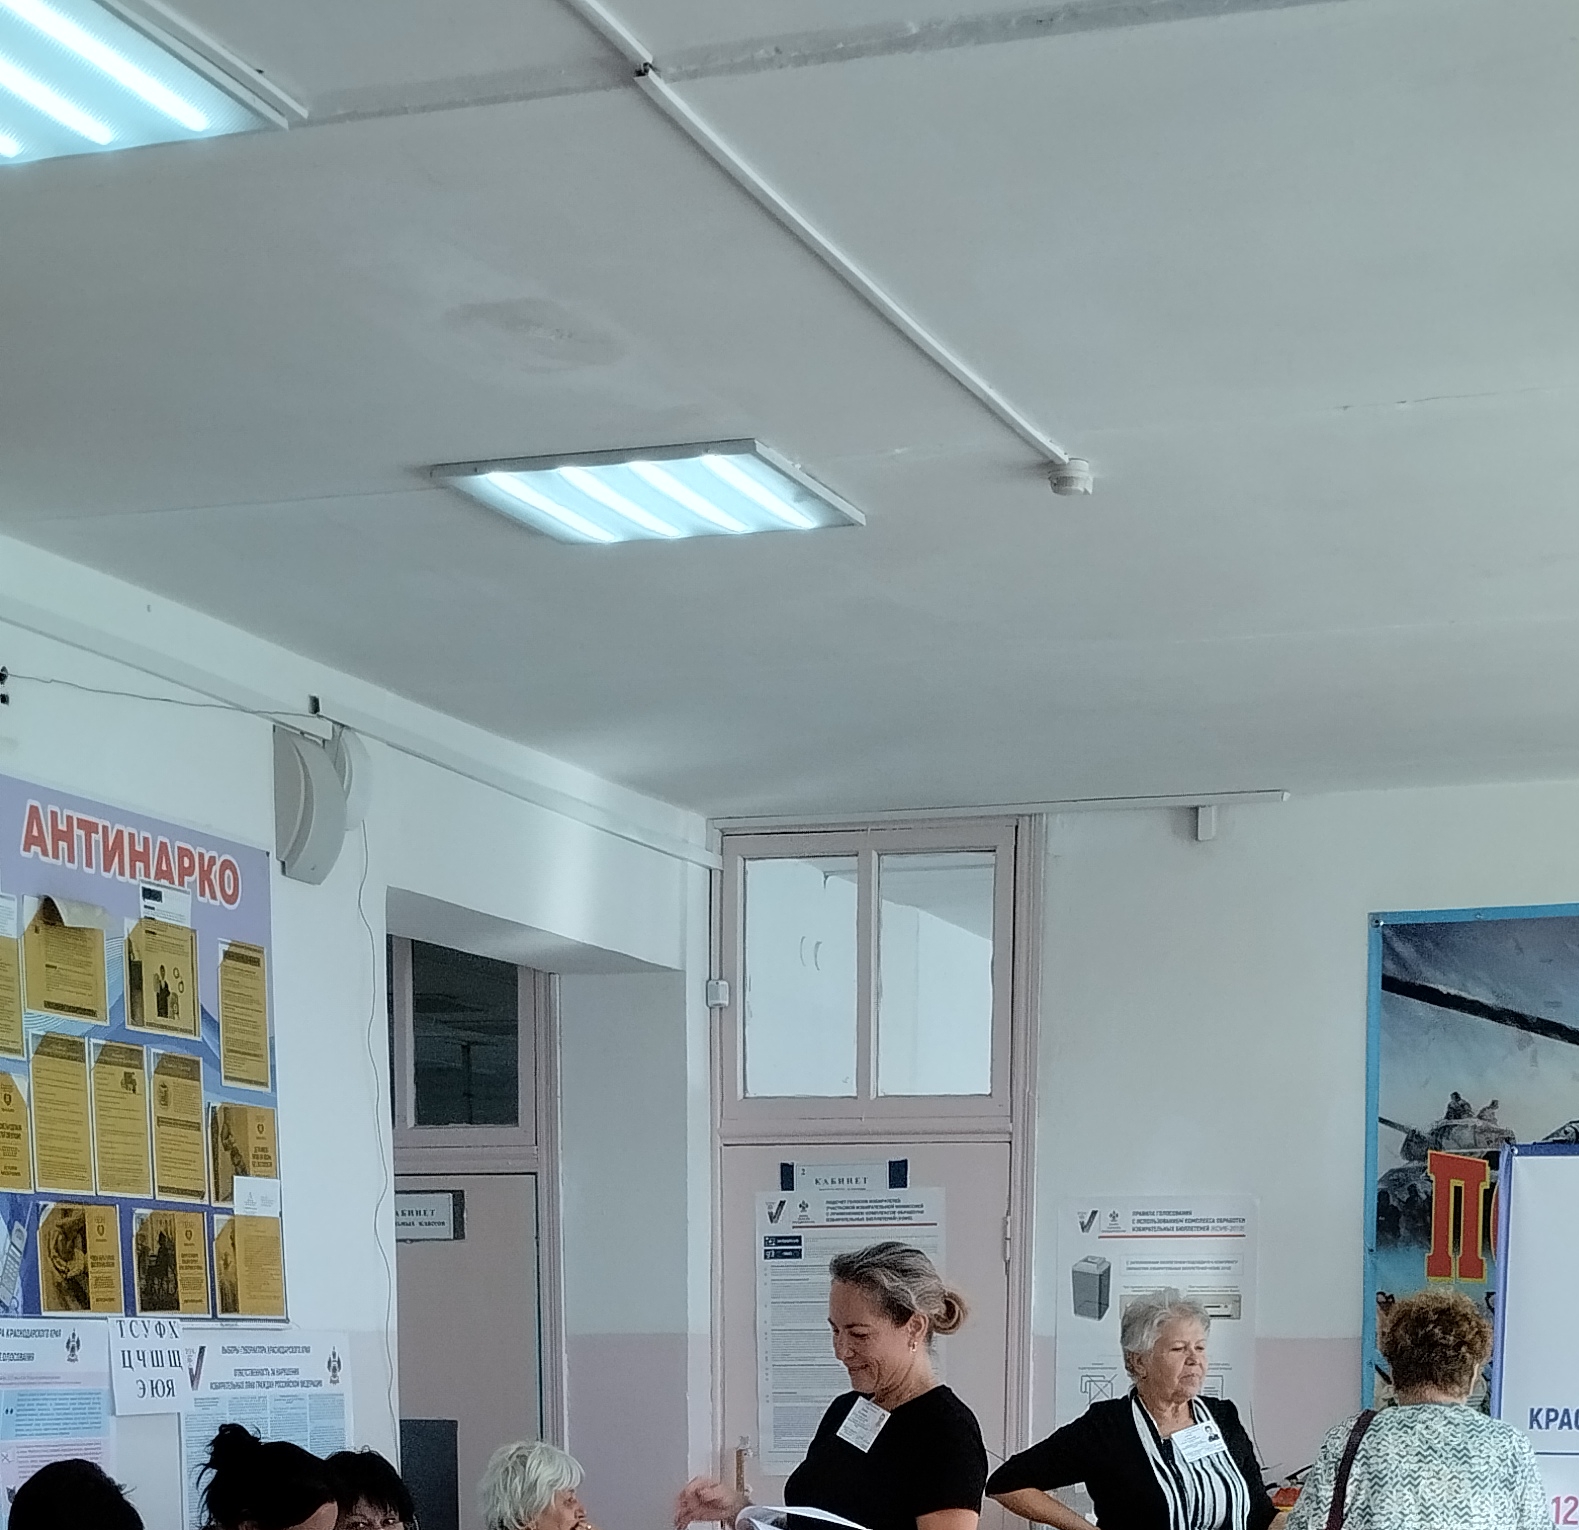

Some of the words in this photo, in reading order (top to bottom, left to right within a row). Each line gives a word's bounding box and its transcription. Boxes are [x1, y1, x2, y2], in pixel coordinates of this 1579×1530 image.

[22, 802, 241, 907] АНТИНАРКО
[814, 1176, 869, 1186] КАБИНЕТ
[395, 1209, 435, 1217] АБИНЕТ
[1426, 1150, 1499, 1283] П
[1551, 1496, 1579, 1525] 12
